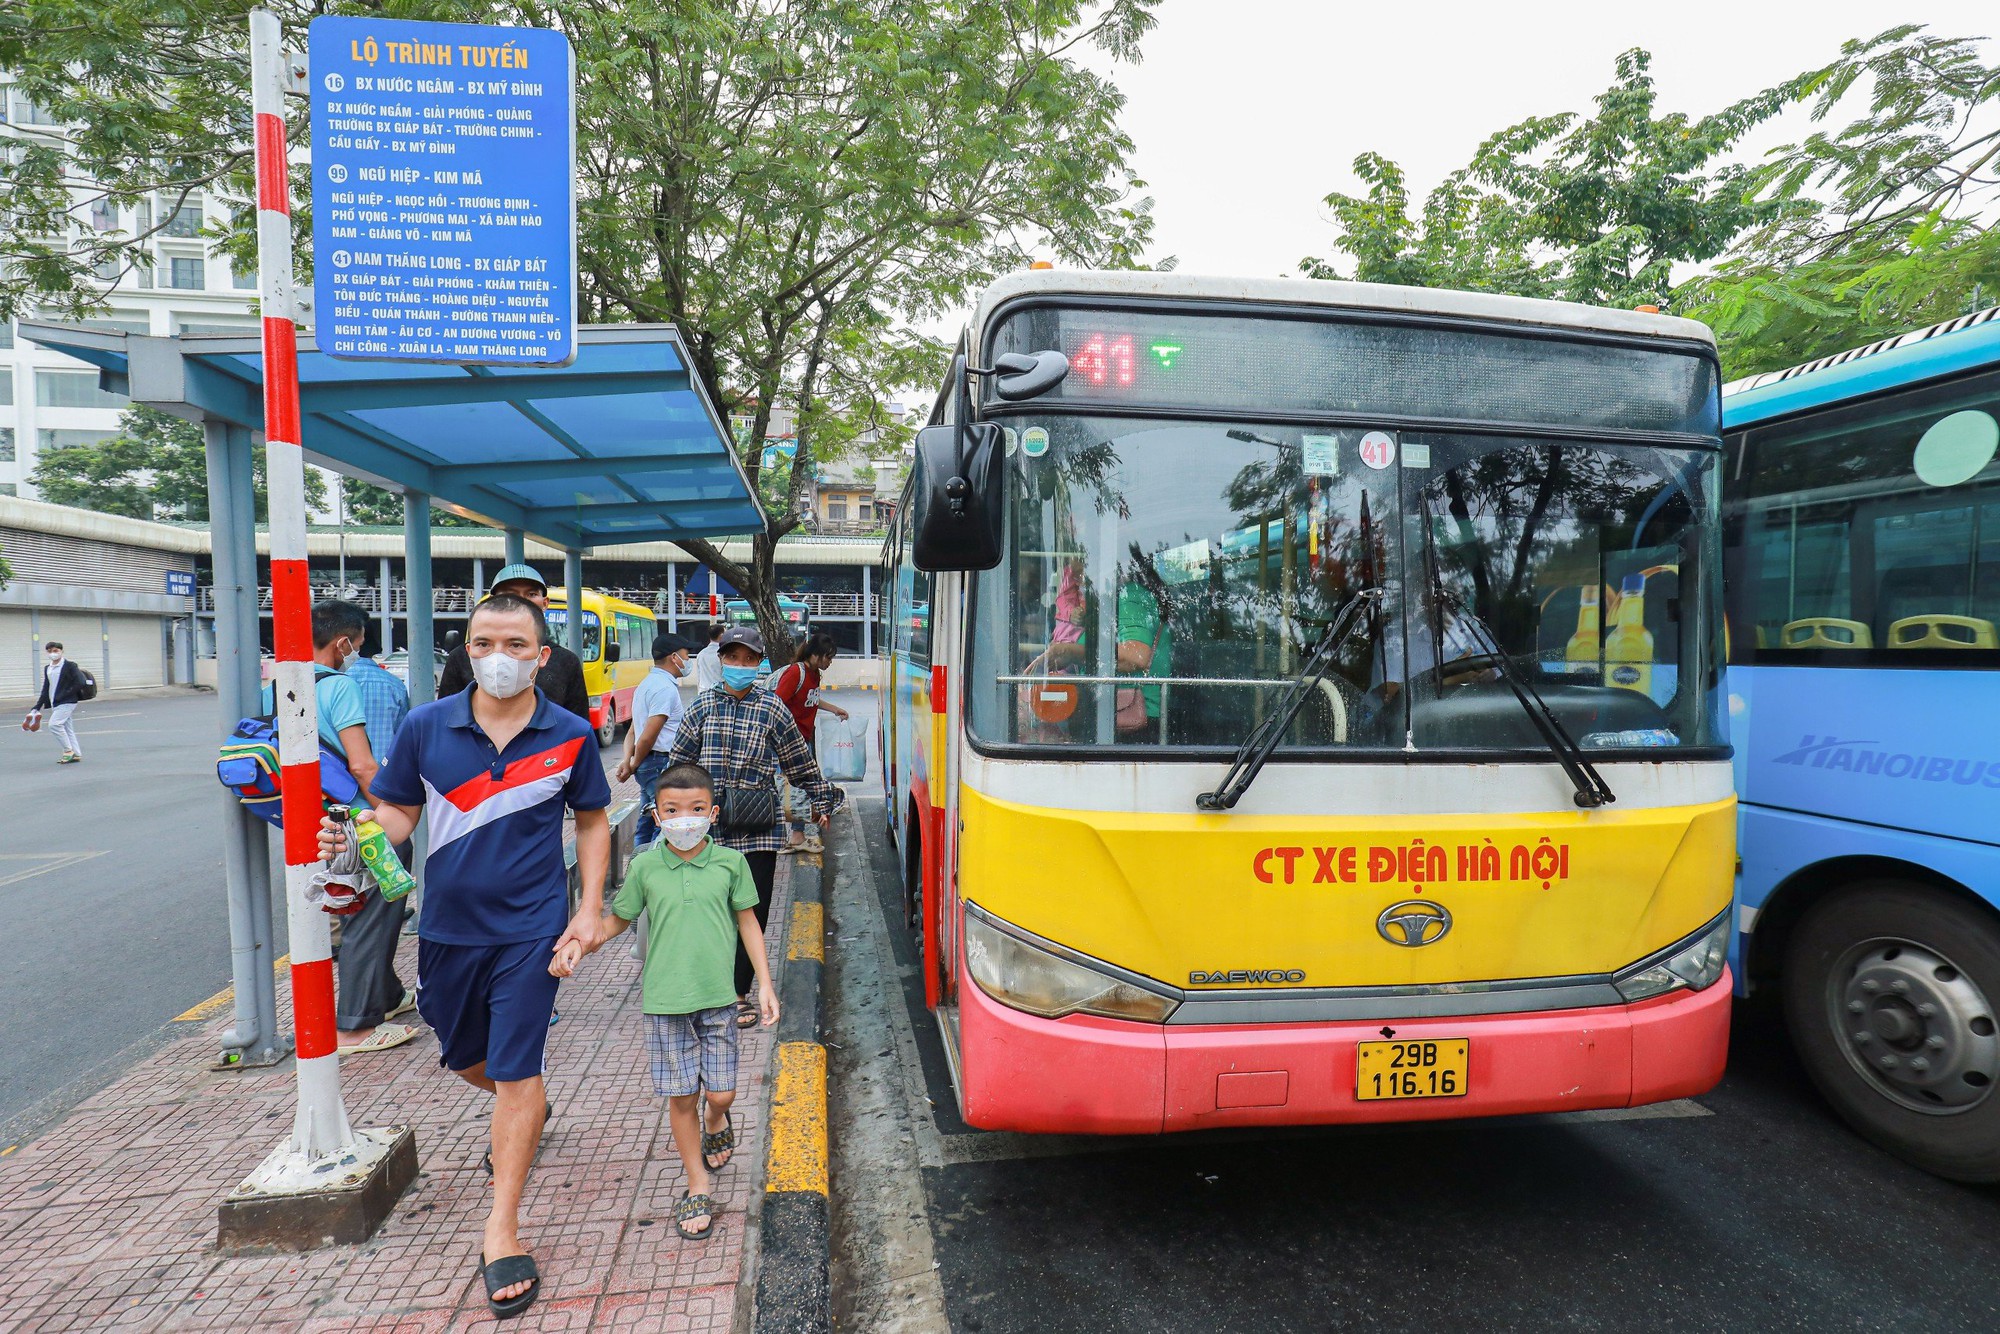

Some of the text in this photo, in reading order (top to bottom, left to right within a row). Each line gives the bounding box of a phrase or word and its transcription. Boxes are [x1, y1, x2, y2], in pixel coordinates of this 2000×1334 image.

[351, 35, 528, 69] LỘ TRÌNH TUYẾN
[355, 77, 373, 90] BX
[376, 76, 412, 92] NƯỚC
[467, 81, 484, 94] BX
[488, 79, 507, 95] MỸ
[510, 80, 542, 96] ĐÌNH
[327, 102, 342, 113] BX
[345, 102, 376, 115] NƯỚC
[423, 104, 445, 118] GIẢI
[448, 105, 484, 119] PHÓNG
[496, 106, 532, 121] QUẢNG
[327, 117, 373, 131] TRƯỜNG
[376, 121, 390, 132] BX
[394, 120, 419, 133] GIÁP
[422, 121, 443, 134] BÁT
[454, 123, 497, 136] TRƯỜNG
[500, 126, 533, 138] CHINH
[354, 135, 380, 150] GIẤY
[391, 140, 406, 152] BX
[409, 140, 426, 152] MỸ
[428, 140, 455, 154] ĐÌNH
[359, 166, 386, 181] NGŨ
[390, 166, 420, 185] HIỆP
[434, 170, 458, 184] KIM
[462, 169, 482, 185] MÃ
[331, 191, 354, 204] NGŨ
[358, 192, 383, 207] HIỆP
[395, 195, 424, 208] NGỌC
[458, 197, 500, 208] TRƯƠNG
[503, 198, 529, 211] ĐỊNH
[332, 207, 354, 220] PHỐ
[358, 210, 388, 223] VỌNG
[399, 212, 444, 224] PHƯƠNG
[447, 214, 468, 224] MAI
[479, 212, 493, 225] XÃ
[495, 212, 517, 226] ĐÀN
[520, 213, 542, 226] HÀO
[332, 226, 356, 238] NAM
[368, 225, 402, 239] GIẢNG
[404, 227, 420, 240] VÕ
[431, 230, 452, 241] KIM
[455, 229, 472, 241] MÃ
[354, 251, 382, 266] NAM
[385, 251, 426, 268] THĂNG
[430, 256, 461, 270] LONG
[474, 258, 490, 270] BX
[493, 255, 520, 271] GIÁP
[524, 256, 547, 272] BÁT
[334, 273, 348, 284] BX
[351, 272, 376, 285] GIÁP
[380, 273, 401, 286] BÁT
[412, 274, 433, 287] GIẢI
[437, 276, 473, 288] PHÓNG
[485, 277, 515, 290] KHÂM
[518, 278, 549, 291] THIÊN
[333, 288, 355, 301] TÔN
[358, 288, 381, 302] ĐỨC
[432, 292, 468, 305] HOÀNG
[472, 293, 496, 307] DIỆU
[507, 293, 548, 307] NGUYỄN
[334, 304, 360, 317] BIỂU
[372, 306, 401, 319] QUÁN
[404, 307, 440, 320] THÁNH
[451, 309, 488, 322] ĐƯỜNG
[491, 312, 526, 322] THANH
[529, 311, 553, 323] NIÊN
[334, 325, 361, 335] NGHI
[398, 324, 413, 336] ÂU
[417, 326, 431, 337] CƠ
[443, 328, 457, 338] AN
[460, 327, 497, 339] DƯƠNG
[500, 328, 536, 340] VƯƠNG
[547, 328, 561, 340] VÕ
[334, 339, 354, 351] CHÍ
[357, 339, 387, 352] CÔNG
[398, 341, 427, 353] XUÂN
[430, 344, 443, 353] LA
[454, 344, 478, 354] NAM
[481, 344, 516, 355] THĂNG
[519, 346, 546, 356] LONG
[1074, 333, 1133, 384] 41
[1362, 441, 1386, 464] 41
[1253, 836, 1569, 894] CT XE ĐIỆN HÀ NỘI
[1189, 970, 1306, 985] DAEWOO
[1390, 1043, 1437, 1068] 29B
[1372, 1070, 1456, 1097] 116.16
[680, 1200, 709, 1213] GUCC
